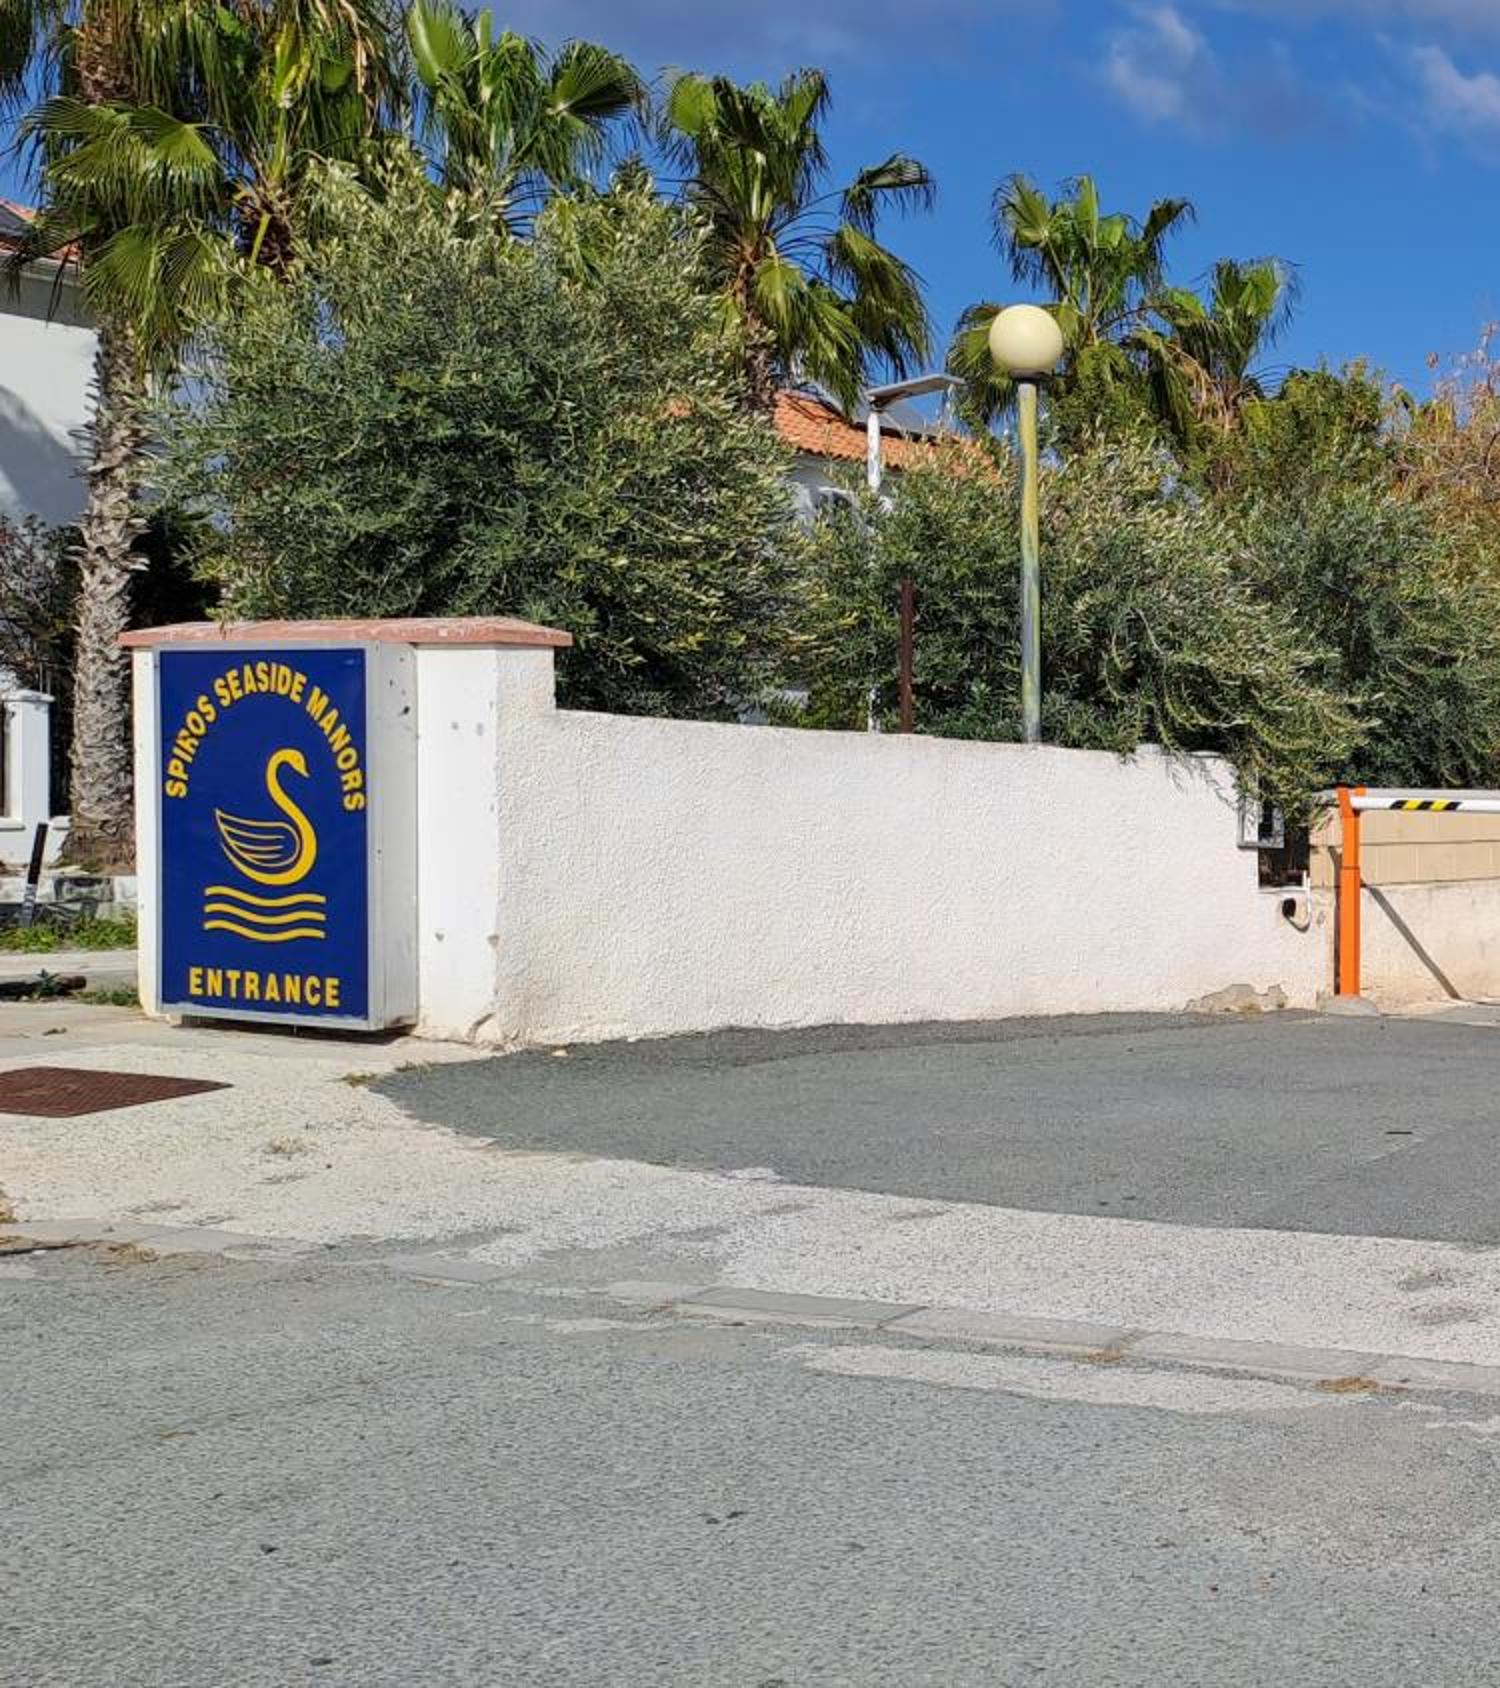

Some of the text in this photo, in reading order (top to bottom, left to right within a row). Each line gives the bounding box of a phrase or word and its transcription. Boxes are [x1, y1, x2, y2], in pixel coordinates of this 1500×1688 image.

[165, 660, 368, 812] SPIROS SEASIDE MANORS
[188, 966, 340, 1008] ENTRANCE
